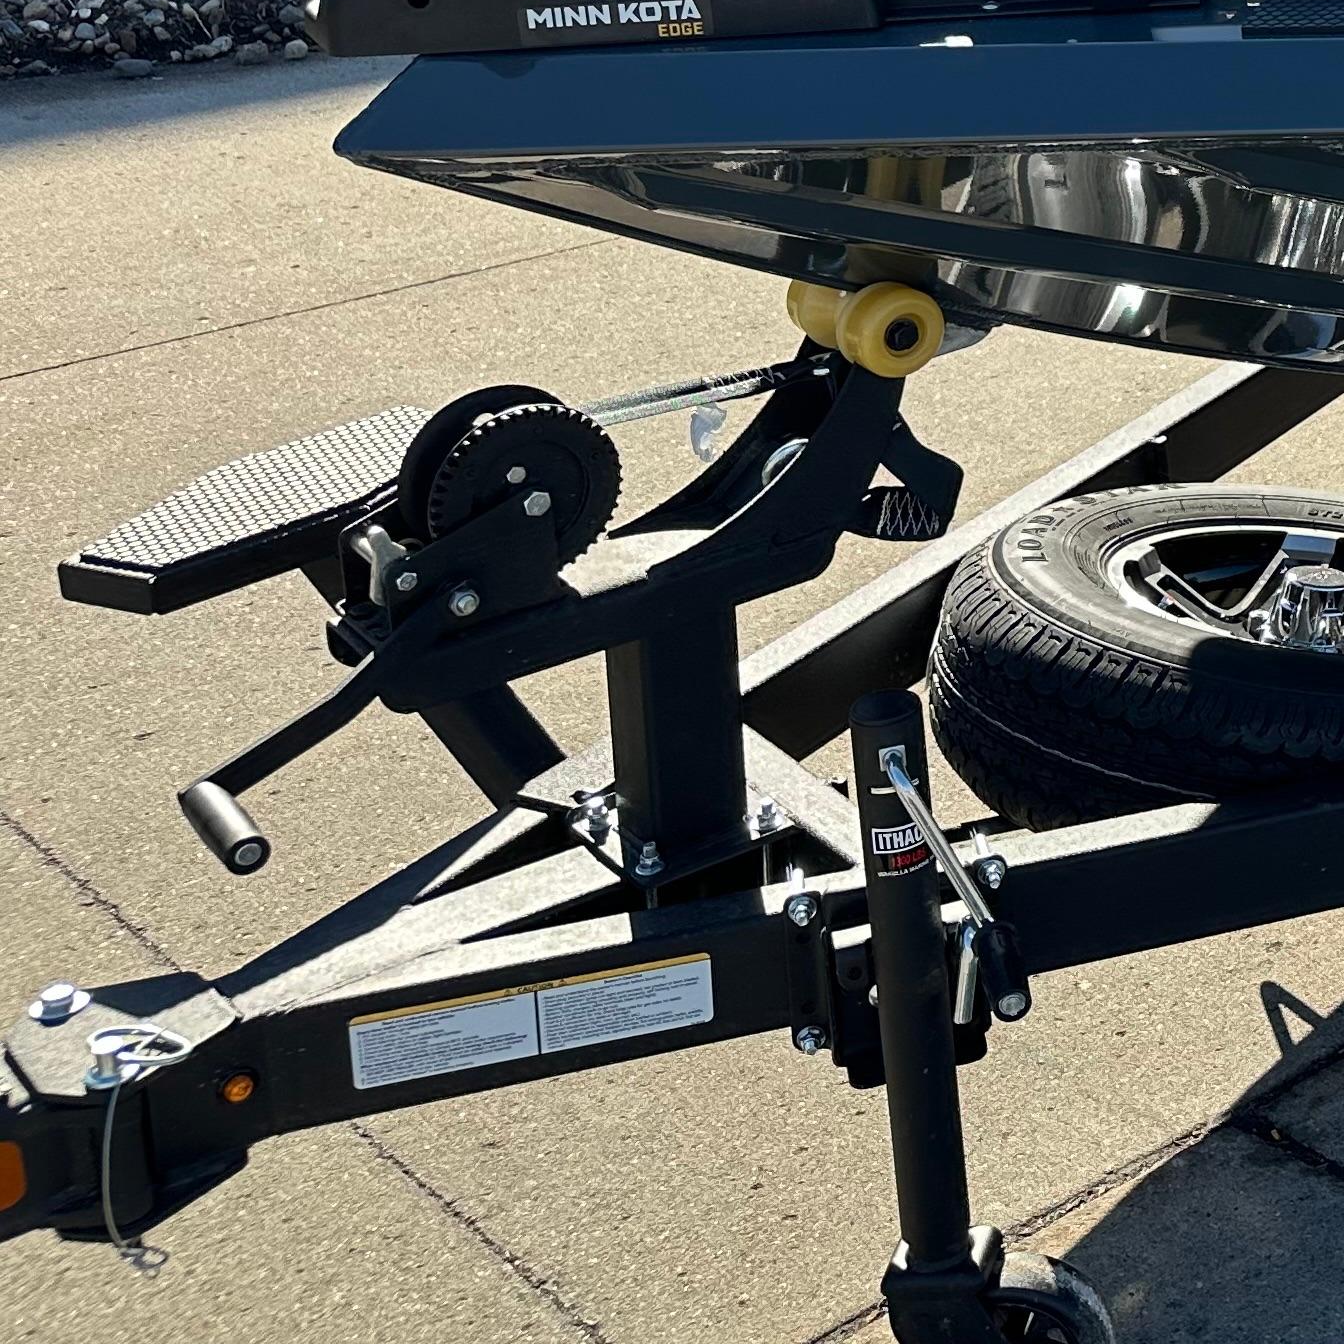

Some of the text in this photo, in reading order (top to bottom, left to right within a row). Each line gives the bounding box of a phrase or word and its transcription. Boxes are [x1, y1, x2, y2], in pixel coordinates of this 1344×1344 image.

[525, 0, 702, 30] MINN KOTA
[657, 21, 705, 38] EDGE
[1017, 514, 1055, 563] LOAD
